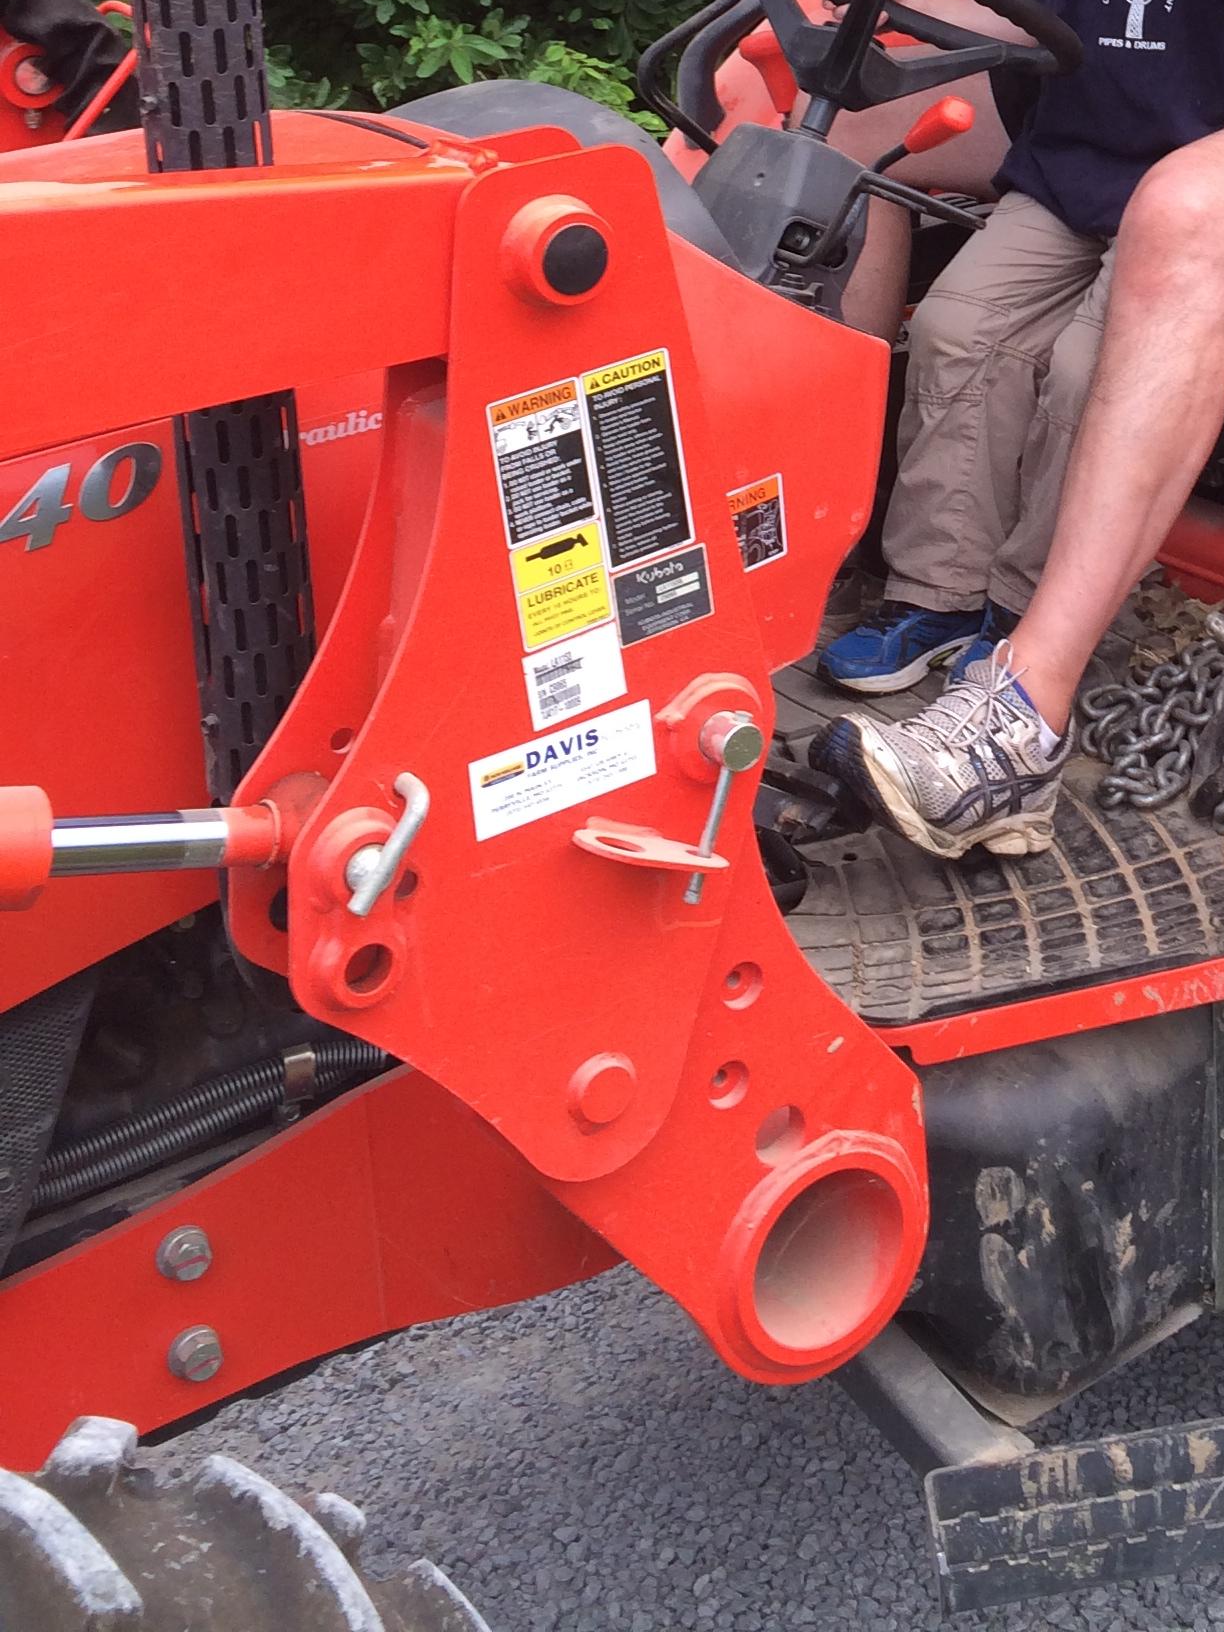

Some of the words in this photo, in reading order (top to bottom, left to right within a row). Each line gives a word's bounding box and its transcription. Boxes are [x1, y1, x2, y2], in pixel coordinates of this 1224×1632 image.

[1098, 36, 1124, 48] PIPES
[1133, 40, 1167, 51] DRUMS
[601, 357, 661, 385] CAUTION
[507, 386, 572, 417] WARNING
[548, 563, 562, 577] 10
[636, 561, 684, 584] Kubota
[527, 572, 600, 608] LUBRICATE
[525, 728, 600, 770] DAVIS
